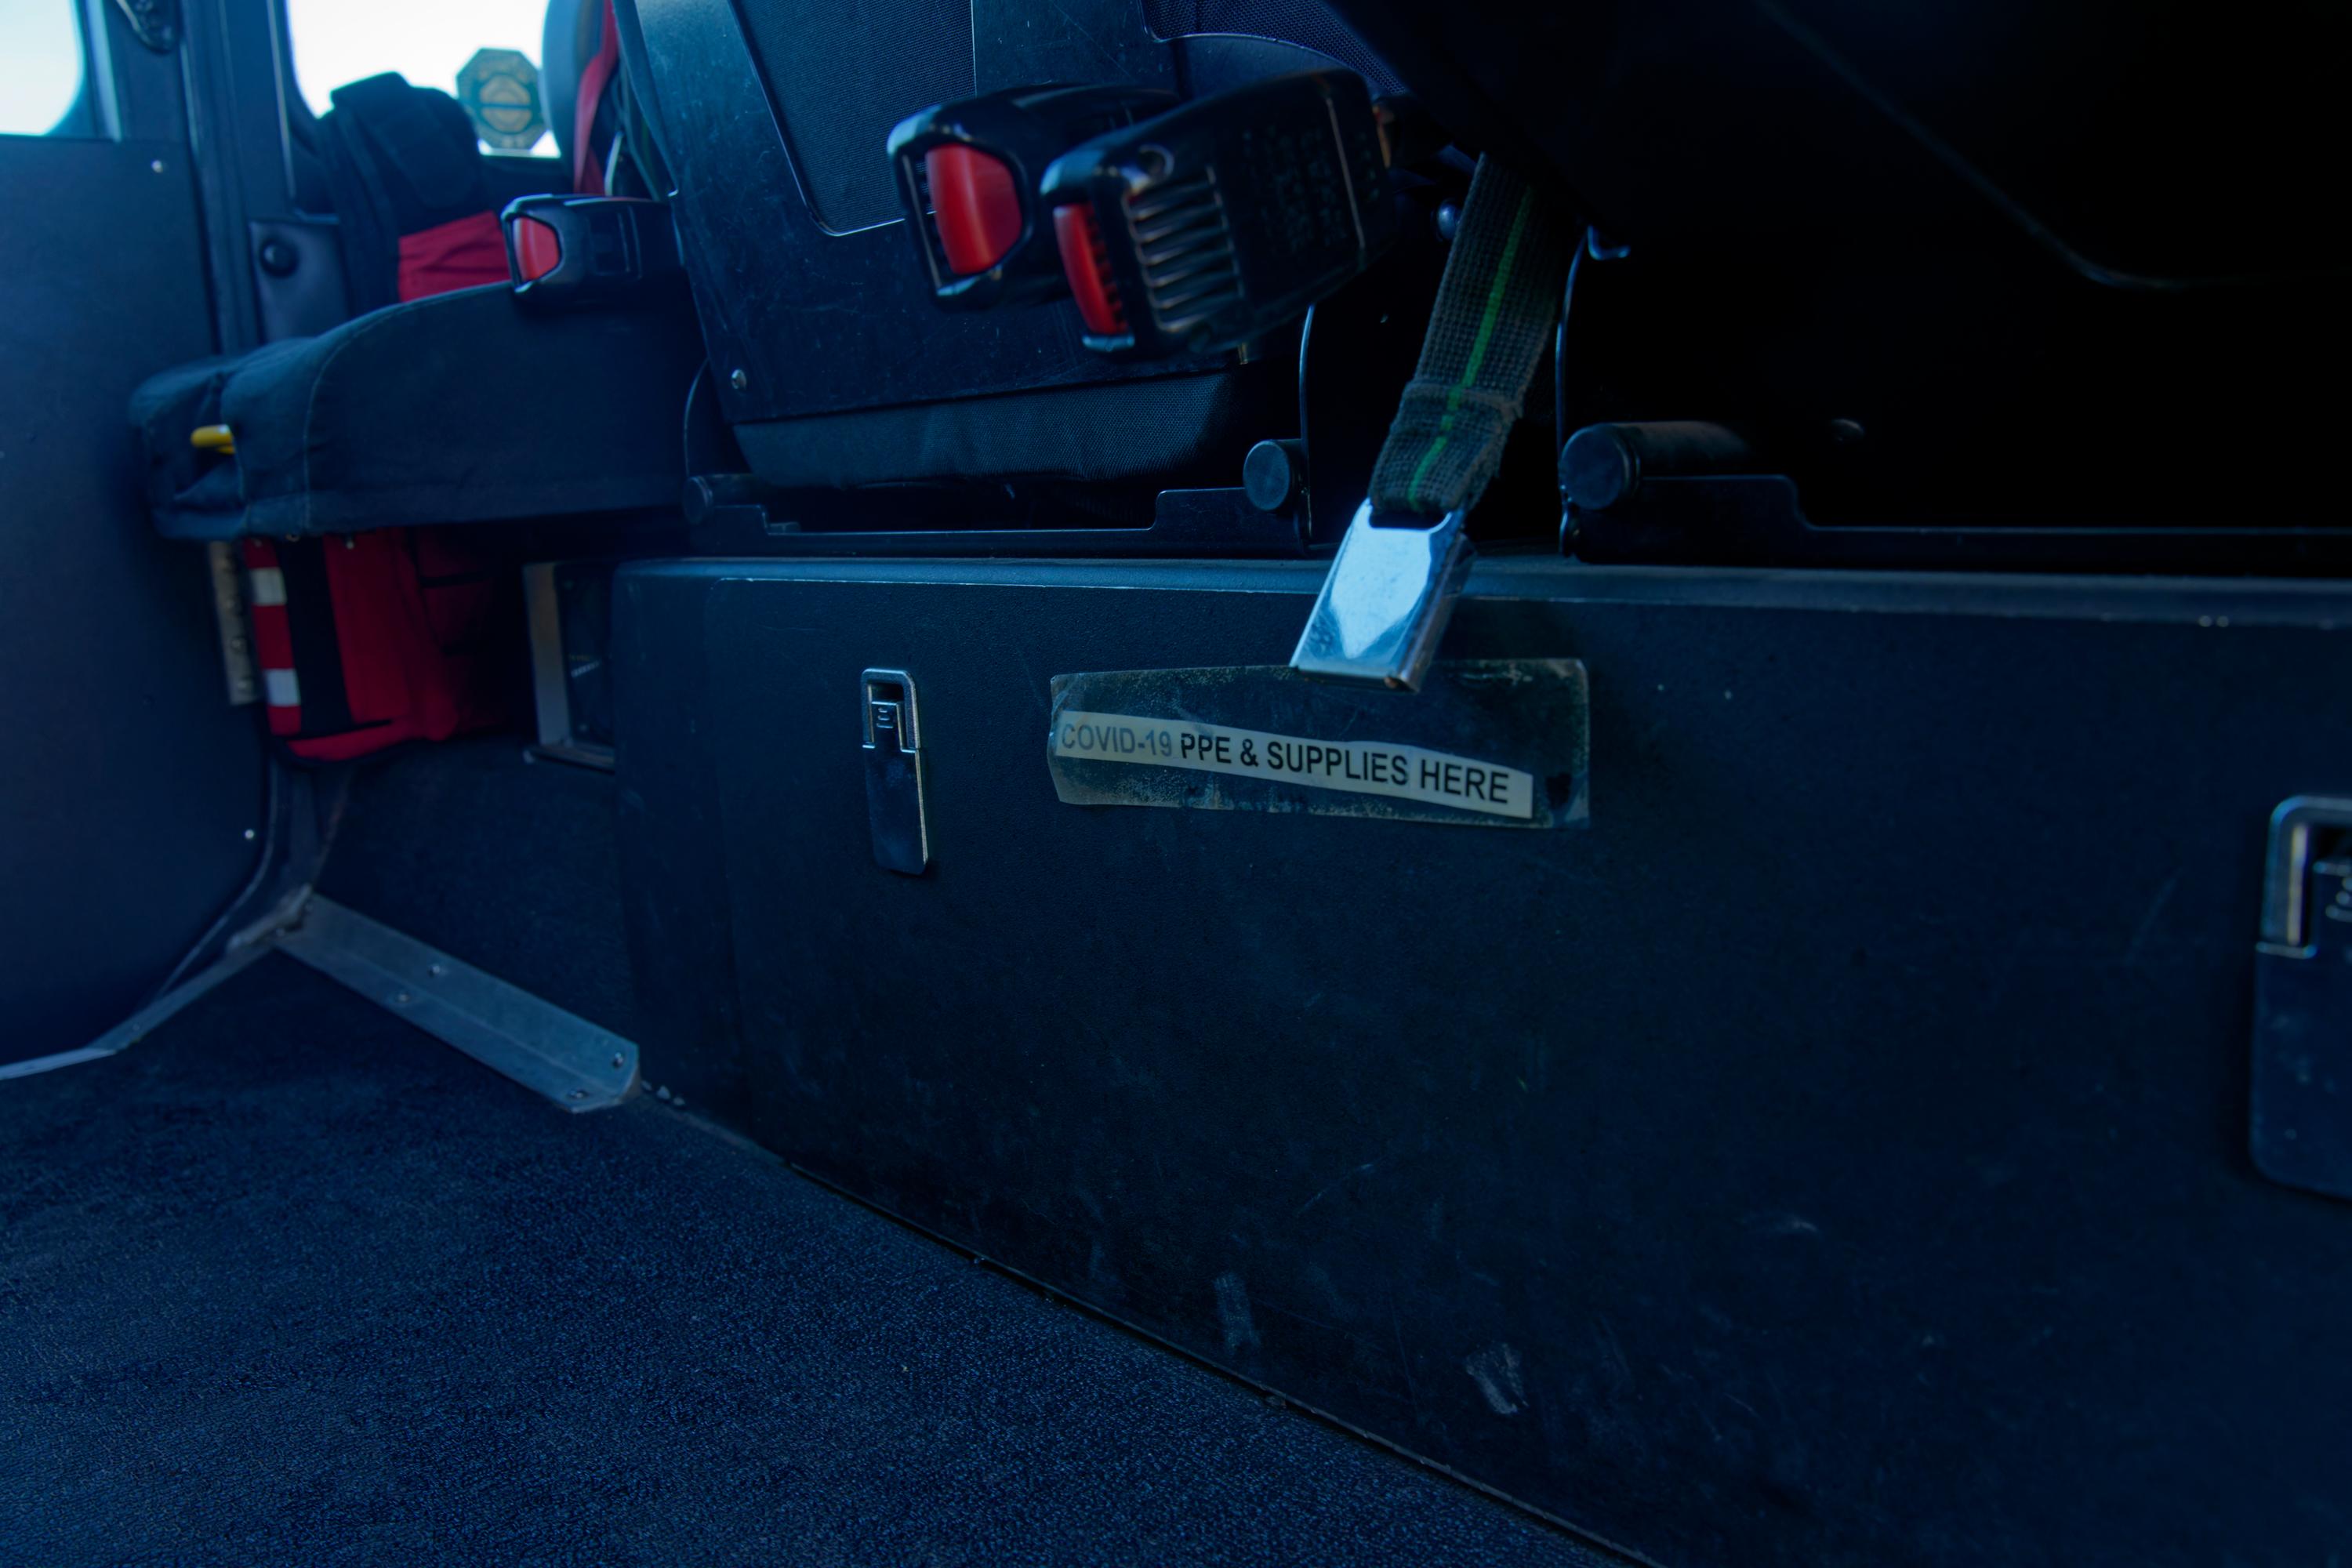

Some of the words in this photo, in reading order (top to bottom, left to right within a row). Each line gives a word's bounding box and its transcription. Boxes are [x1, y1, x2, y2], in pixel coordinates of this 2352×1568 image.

[1062, 723, 1172, 757] COVID-19
[1180, 733, 1232, 764] PPE
[1240, 739, 1259, 766] &
[1266, 741, 1408, 785] SUPPLIES
[1420, 760, 1509, 804] HERE
